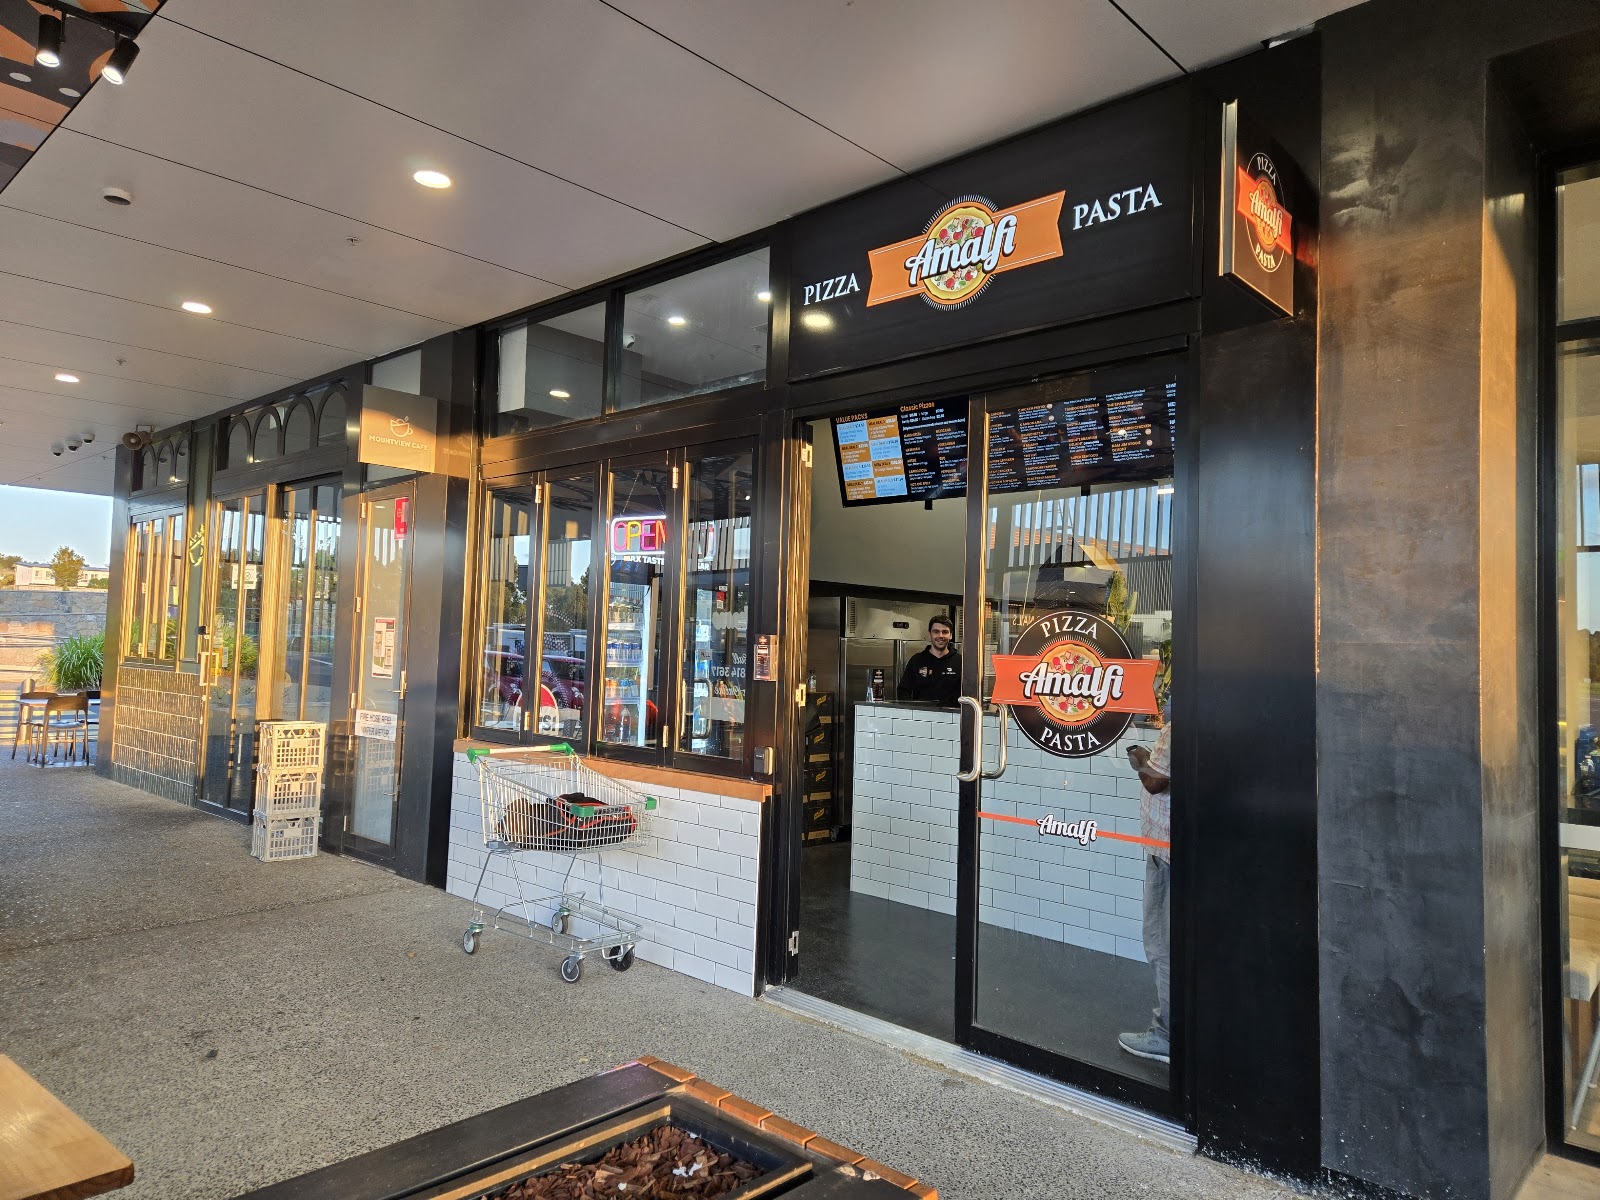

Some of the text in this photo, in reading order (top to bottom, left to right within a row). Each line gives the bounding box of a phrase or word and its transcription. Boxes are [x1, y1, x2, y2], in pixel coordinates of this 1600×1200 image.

[1257, 156, 1276, 186] PIZZA
[1072, 182, 1162, 230] PASTA
[1249, 189, 1283, 239] Amalfi
[904, 214, 1018, 287] Amalfi
[1255, 242, 1276, 269] PASTA
[803, 272, 860, 305] PIZZA
[368, 435, 429, 451] MOUNTVIEW CAFE
[613, 520, 666, 551] OPEN
[1040, 615, 1098, 640] PIZZA
[1019, 662, 1124, 709] Amalfi
[1039, 726, 1101, 751] PASTA
[1036, 814, 1098, 846] Amalfi
